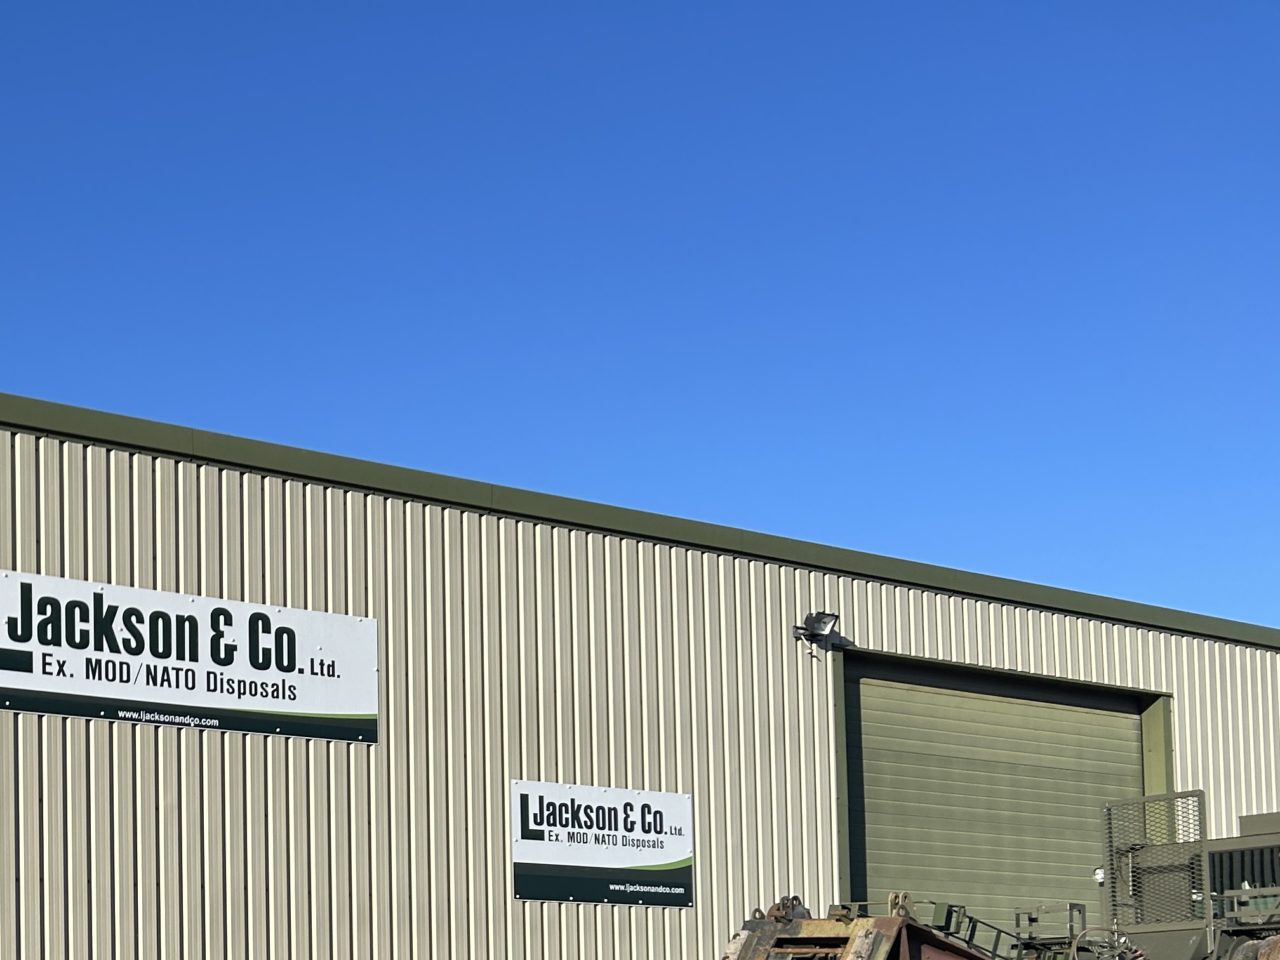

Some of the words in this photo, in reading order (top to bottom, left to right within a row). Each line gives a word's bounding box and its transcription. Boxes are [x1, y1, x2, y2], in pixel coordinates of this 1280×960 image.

[210, 607, 238, 667] &
[248, 611, 305, 675] Co.
[310, 657, 341, 679] Ltd.
[41, 653, 74, 679] Ex.
[85, 657, 196, 691] MOD/NATO
[207, 671, 297, 701] Disposals
[118, 709, 219, 727] www.ljacksonandco.com
[623, 802, 636, 835] &
[641, 803, 668, 835] Co.
[670, 826, 685, 837] Ltd.
[548, 830, 563, 843] Ex.
[567, 831, 618, 846] MOD/NATO
[622, 835, 665, 850] Disposals
[609, 883, 685, 895] www.ljacksonandco.com
